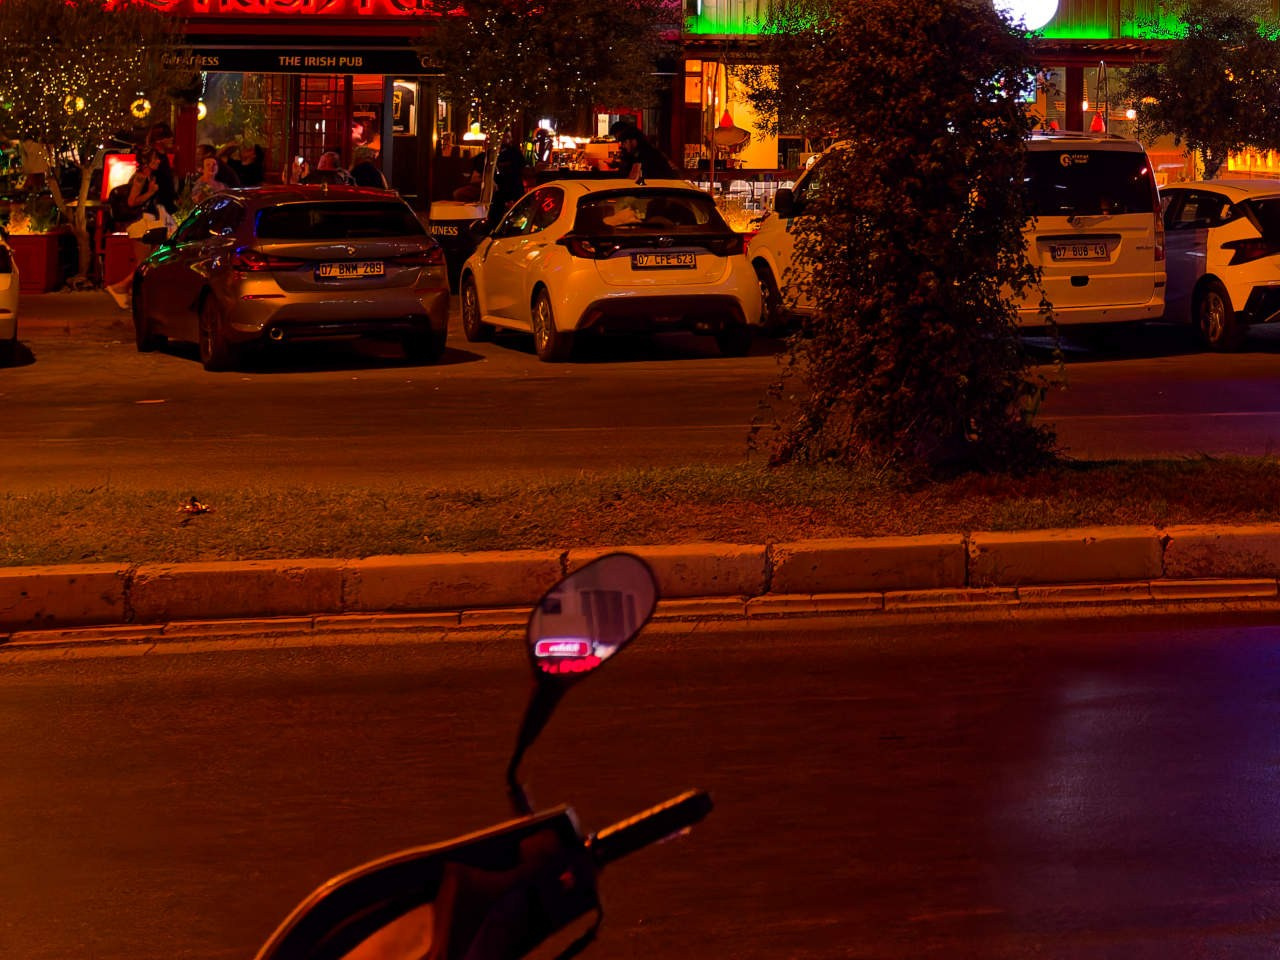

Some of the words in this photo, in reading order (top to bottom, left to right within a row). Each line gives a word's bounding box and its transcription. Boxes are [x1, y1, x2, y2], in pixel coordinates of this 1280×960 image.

[278, 56, 302, 67] THE
[304, 56, 336, 67] IRISH
[339, 56, 363, 68] PUB
[638, 254, 649, 265] 07
[321, 264, 333, 275] 07
